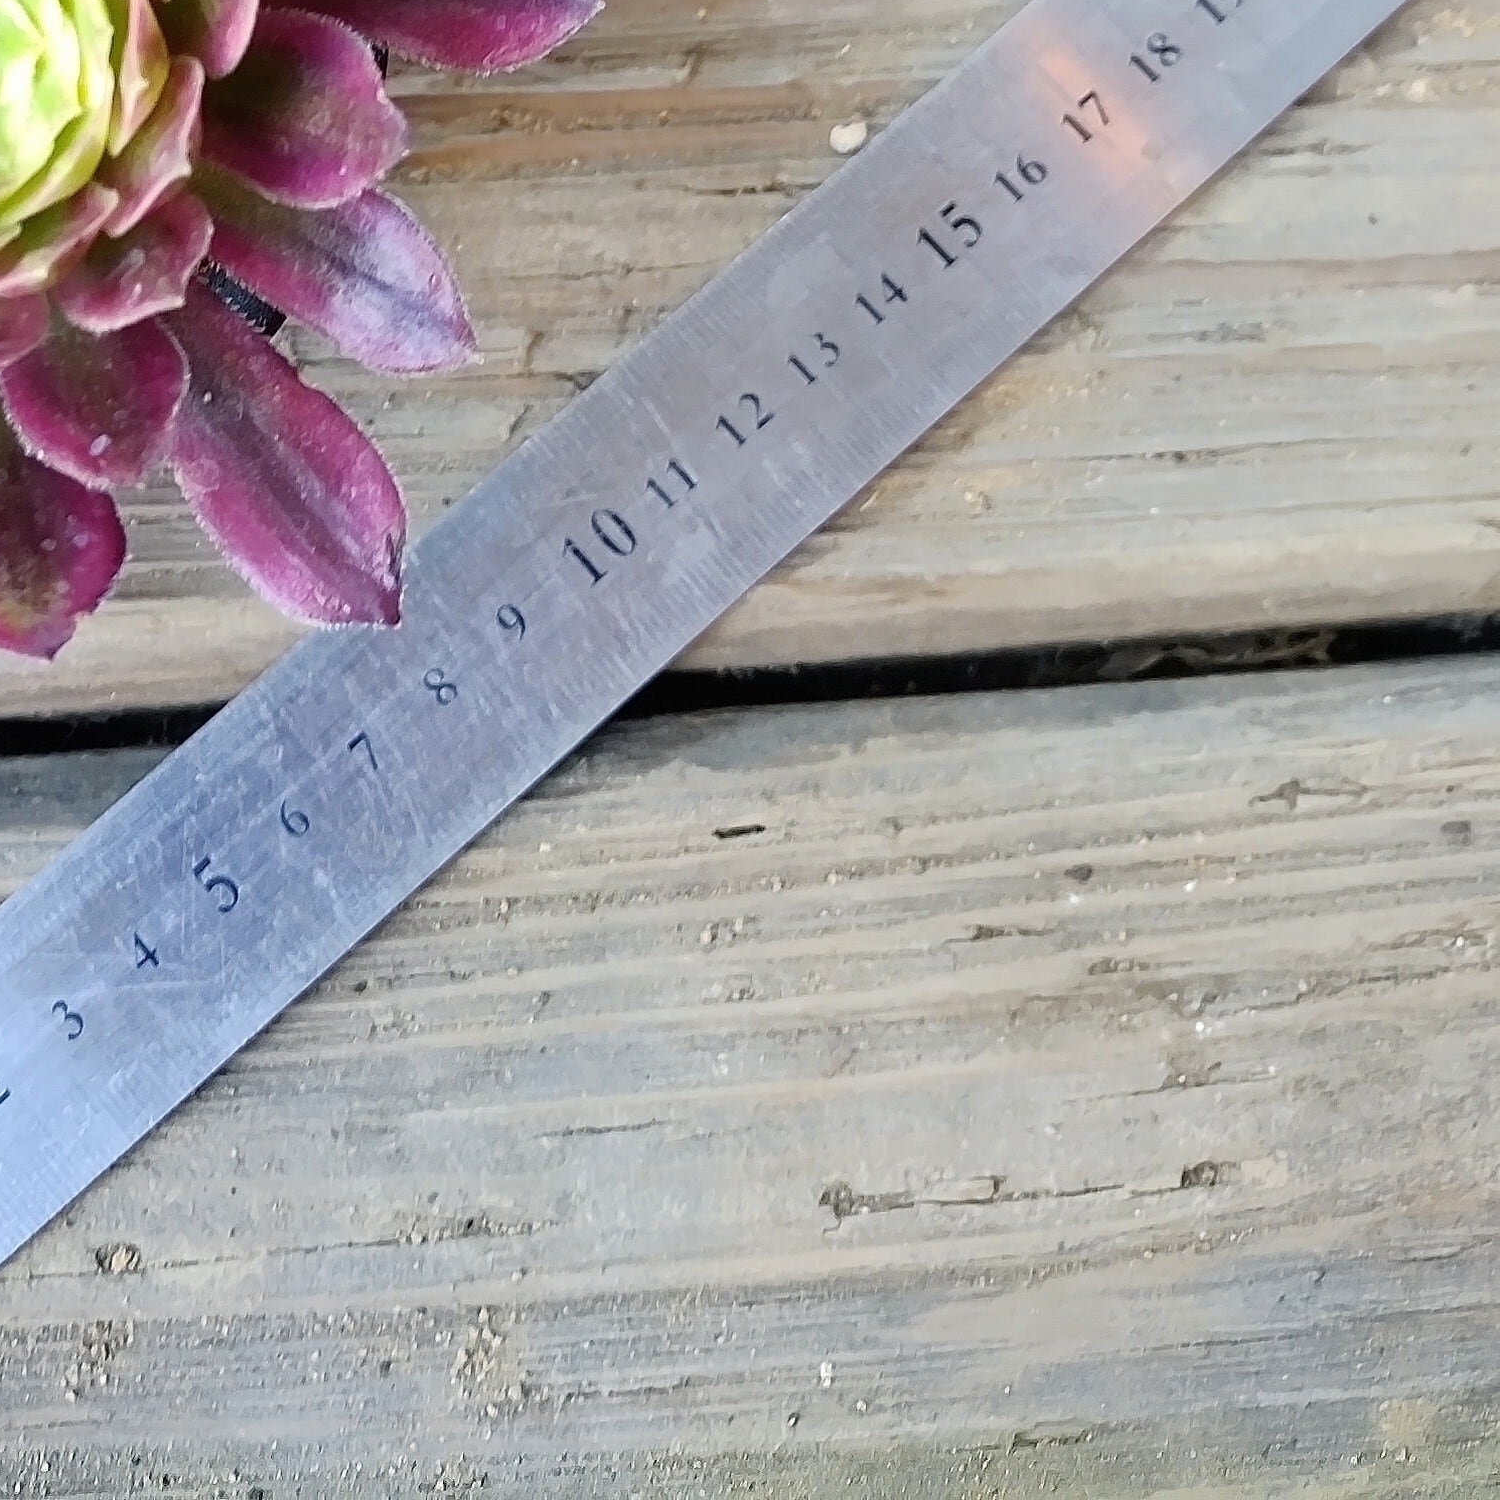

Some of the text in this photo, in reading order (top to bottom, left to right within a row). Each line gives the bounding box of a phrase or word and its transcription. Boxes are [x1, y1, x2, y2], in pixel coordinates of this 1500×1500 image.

[51, 1000, 84, 1040] 3
[133, 932, 160, 968] 4
[193, 857, 240, 913] 5
[281, 799, 310, 837] 6
[347, 731, 378, 770] 7
[423, 668, 458, 706] 8
[496, 603, 526, 641] 9
[562, 508, 638, 586] 10
[646, 457, 698, 508] 11
[716, 393, 775, 447] 12
[787, 332, 841, 385] 13
[853, 273, 908, 325] 14
[917, 200, 983, 270] 15
[993, 153, 1049, 202] 16
[1062, 90, 1110, 143] 17
[1129, 32, 1182, 83] 18
